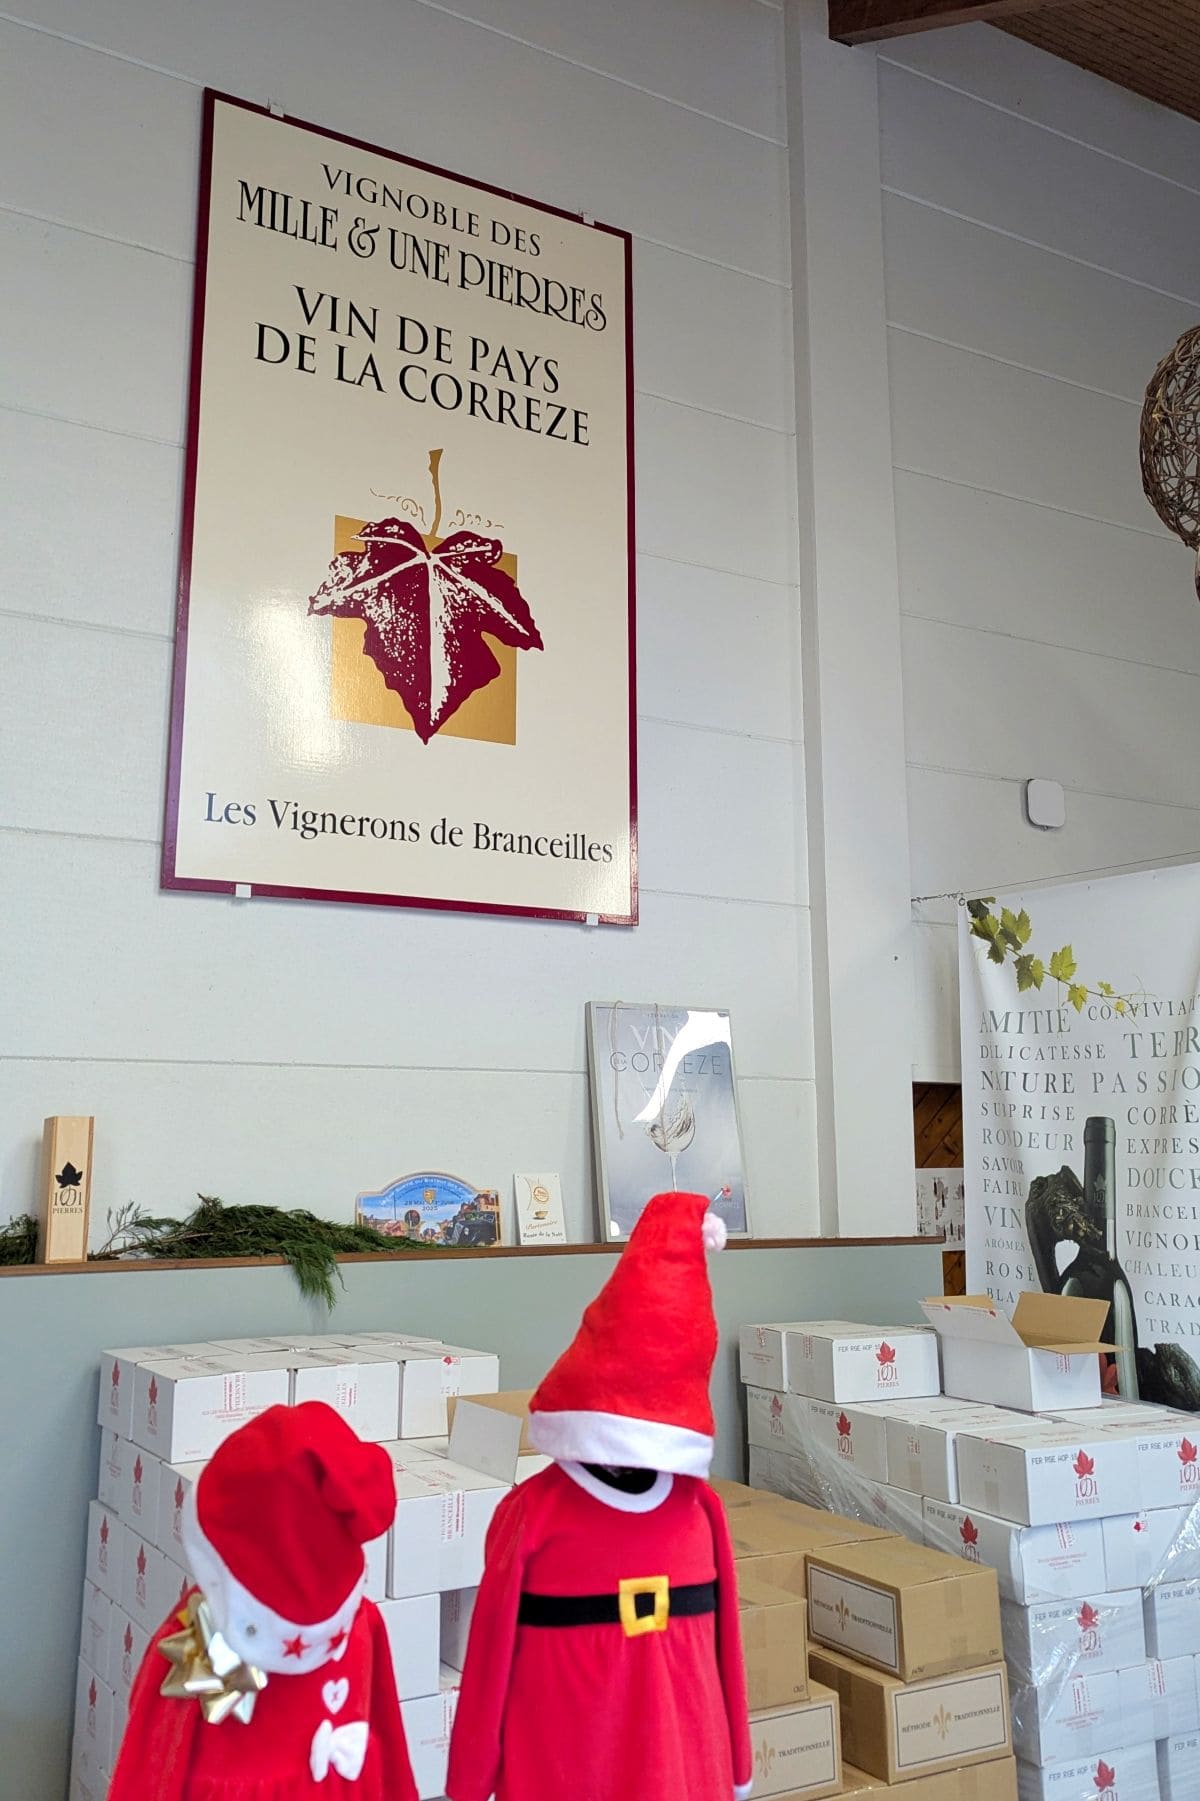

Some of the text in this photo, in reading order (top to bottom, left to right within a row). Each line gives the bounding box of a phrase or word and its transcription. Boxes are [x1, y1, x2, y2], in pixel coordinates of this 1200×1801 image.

[320, 163, 542, 257] VIGNOBLE DES
[236, 180, 607, 332] MILLE & UNE PIERRES
[292, 285, 559, 393] VIN DE PAYS
[254, 321, 591, 447] DE LA CORREZE
[204, 792, 614, 863] Les Vignerons de Branceilles
[979, 1002, 1071, 1035] AMITIÉ
[610, 1051, 723, 1075] COREZE
[1092, 1066, 1200, 1094] PASSIO
[1127, 1099, 1200, 1126] CORRÈ
[1127, 1137, 1200, 1154] EXPRES
[984, 1205, 1022, 1229] VIN
[1126, 1203, 1199, 1221] BRANCEI
[985, 1260, 1034, 1281] ROSÉ
[1124, 1259, 1198, 1279] CHALEU
[1145, 1290, 1200, 1308] CARA
[778, 1740, 831, 1758] TRADITIONNELLE
